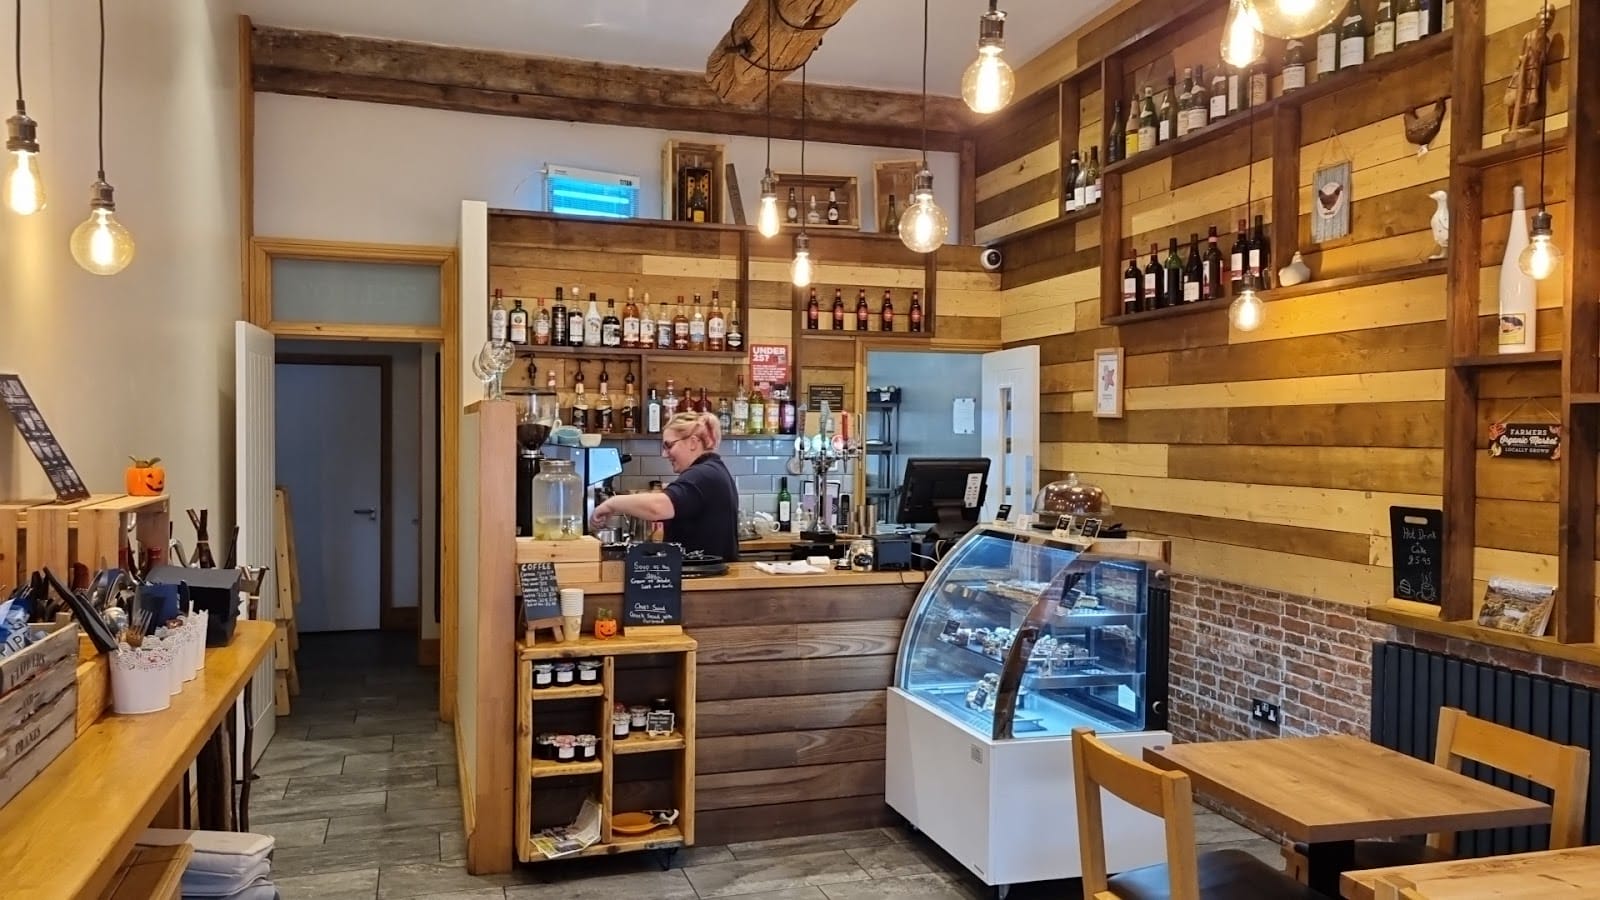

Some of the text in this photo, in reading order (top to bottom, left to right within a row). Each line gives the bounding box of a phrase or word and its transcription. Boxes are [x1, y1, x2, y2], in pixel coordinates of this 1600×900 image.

[752, 346, 786, 355] UNDER
[1510, 428, 1548, 436] FARMERS
[1500, 435, 1558, 446] Organic Market
[1402, 527, 1437, 540] Hot Drink
[1411, 545, 1427, 554] Cake
[521, 563, 552, 571] COFFEE
[633, 561, 650, 571] Soup
